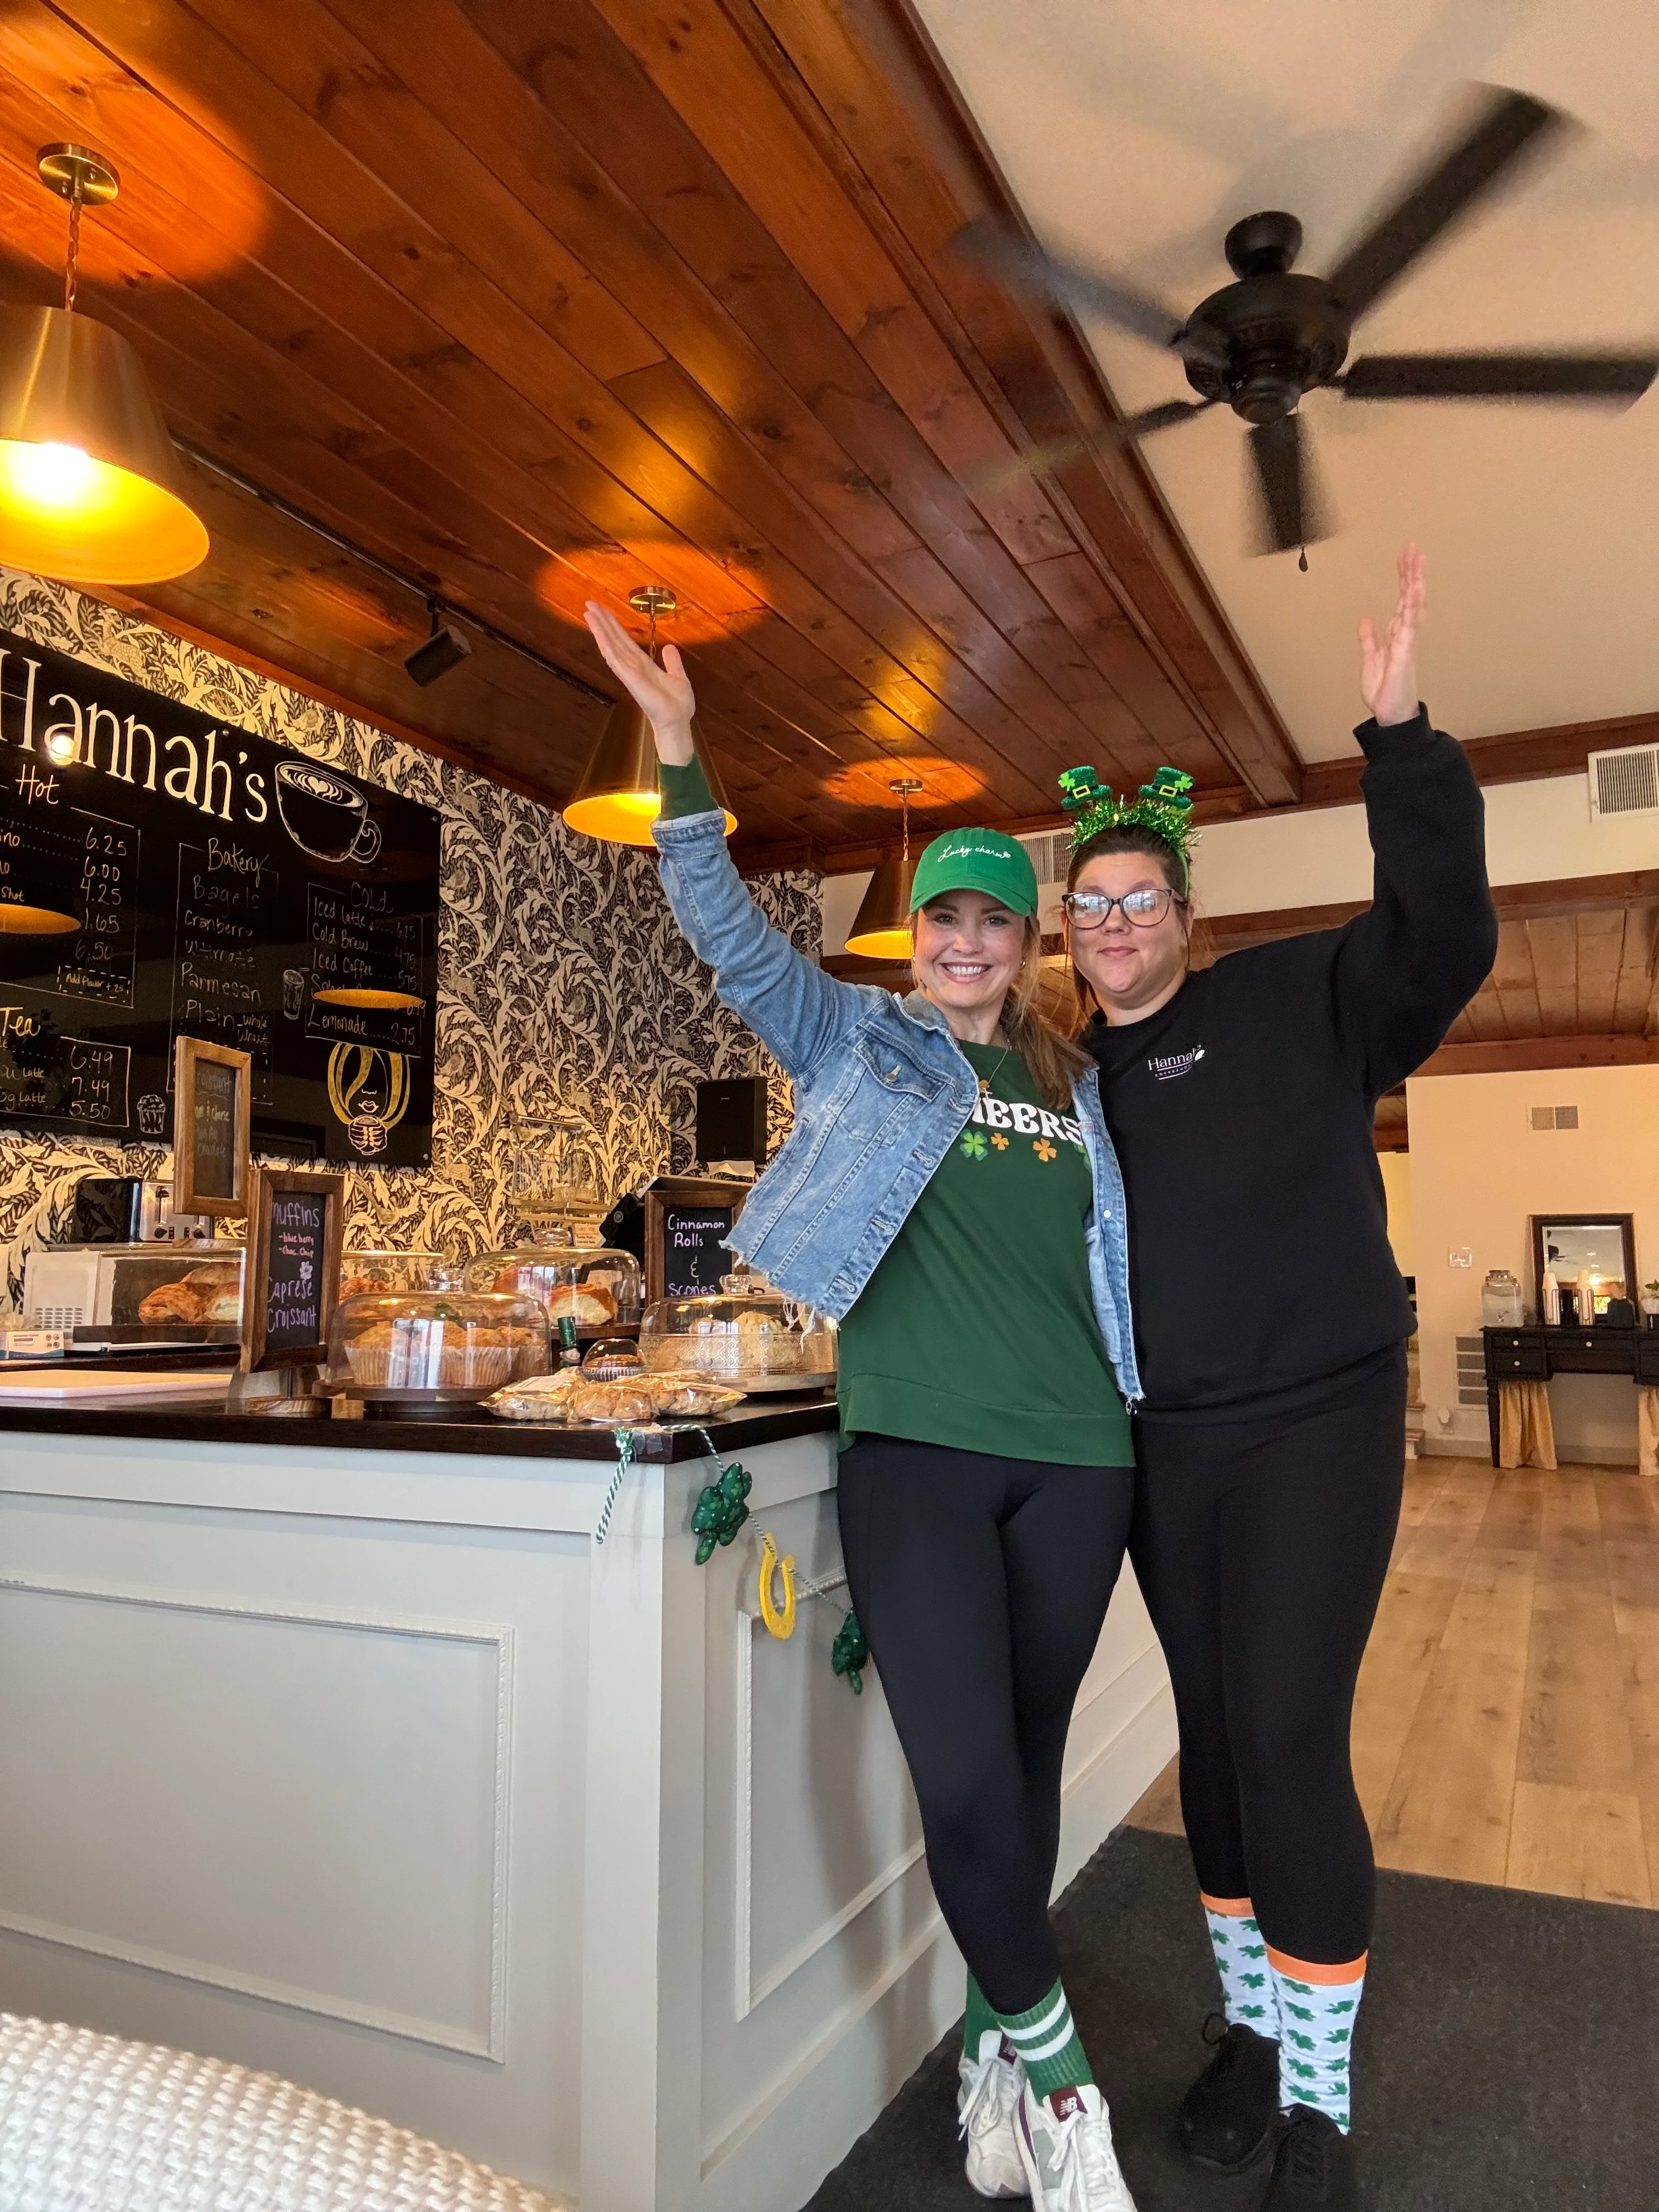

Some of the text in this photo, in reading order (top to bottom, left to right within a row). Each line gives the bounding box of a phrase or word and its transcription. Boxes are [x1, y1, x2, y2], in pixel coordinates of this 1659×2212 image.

[0, 648, 267, 822] Hannah's
[15, 764, 59, 804] Hot
[85, 827, 127, 856] 6.25
[937, 845, 1005, 862] Lucky charm
[84, 856, 120, 881] 6.00
[208, 838, 262, 888] Bakery
[80, 878, 121, 905] 4.25
[314, 896, 335, 918] Iced
[312, 923, 337, 944] Cold
[341, 929, 368, 951] Brew
[313, 947, 338, 971] Iced
[343, 957, 373, 979] Coffee
[66, 973, 80, 984] Add
[182, 962, 261, 1005] Parmesan
[0, 1007, 41, 1036] Tea
[308, 1004, 368, 1035] Lemonade
[70, 1045, 112, 1074] 6.49
[72, 1076, 109, 1102] 7.49
[69, 1100, 110, 1119] 5.50
[668, 1214, 725, 1231] Cinnamon
[674, 1232, 703, 1247] Rolls
[668, 1283, 716, 1296] Scones
